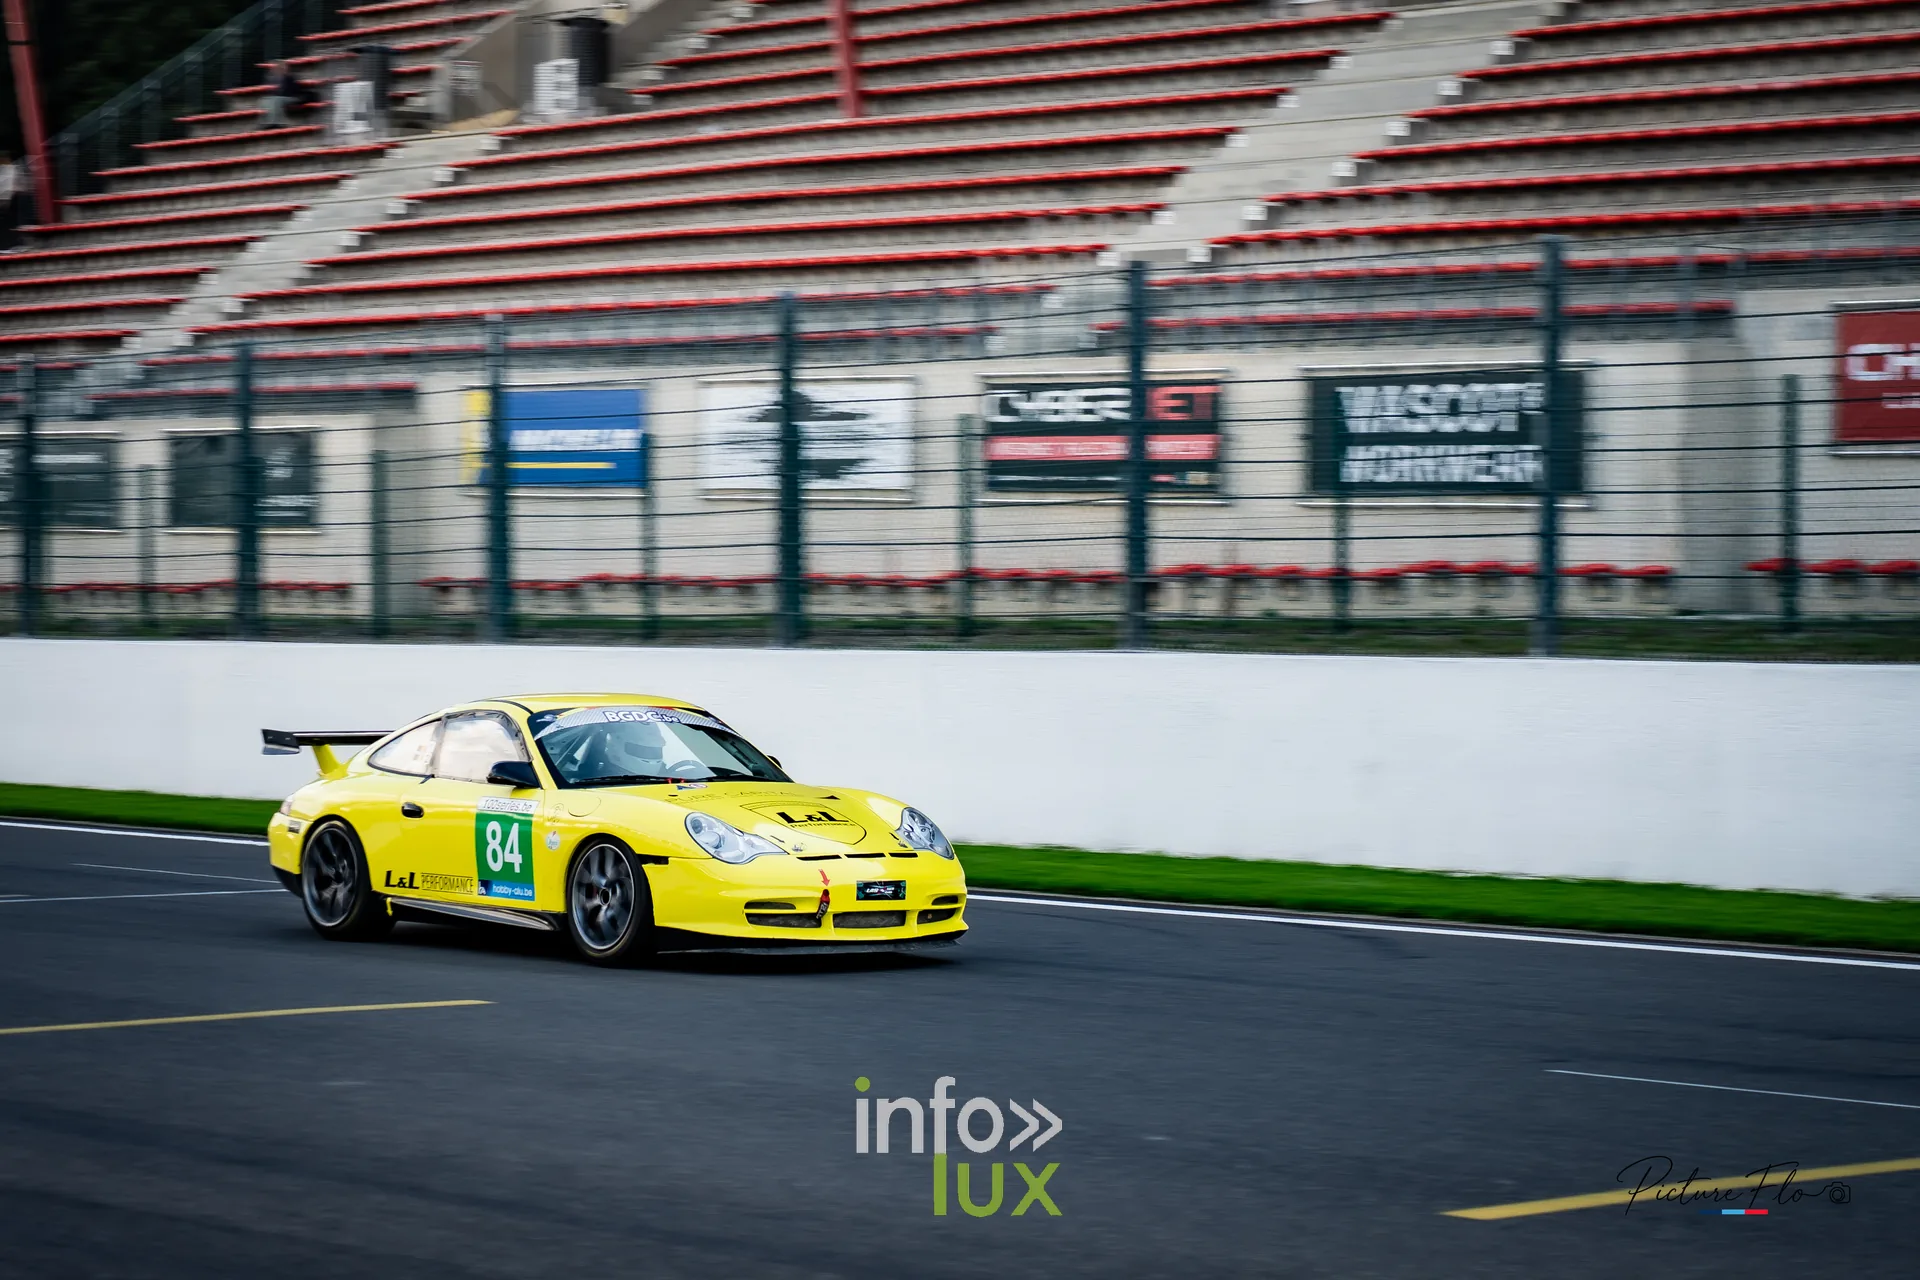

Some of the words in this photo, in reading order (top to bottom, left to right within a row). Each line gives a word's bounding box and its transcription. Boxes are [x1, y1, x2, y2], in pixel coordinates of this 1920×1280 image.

[603, 711, 681, 723] BGDC.be
[486, 820, 523, 873] 84
[384, 870, 419, 890] L&L
[421, 873, 474, 894] PERFORMANCE
